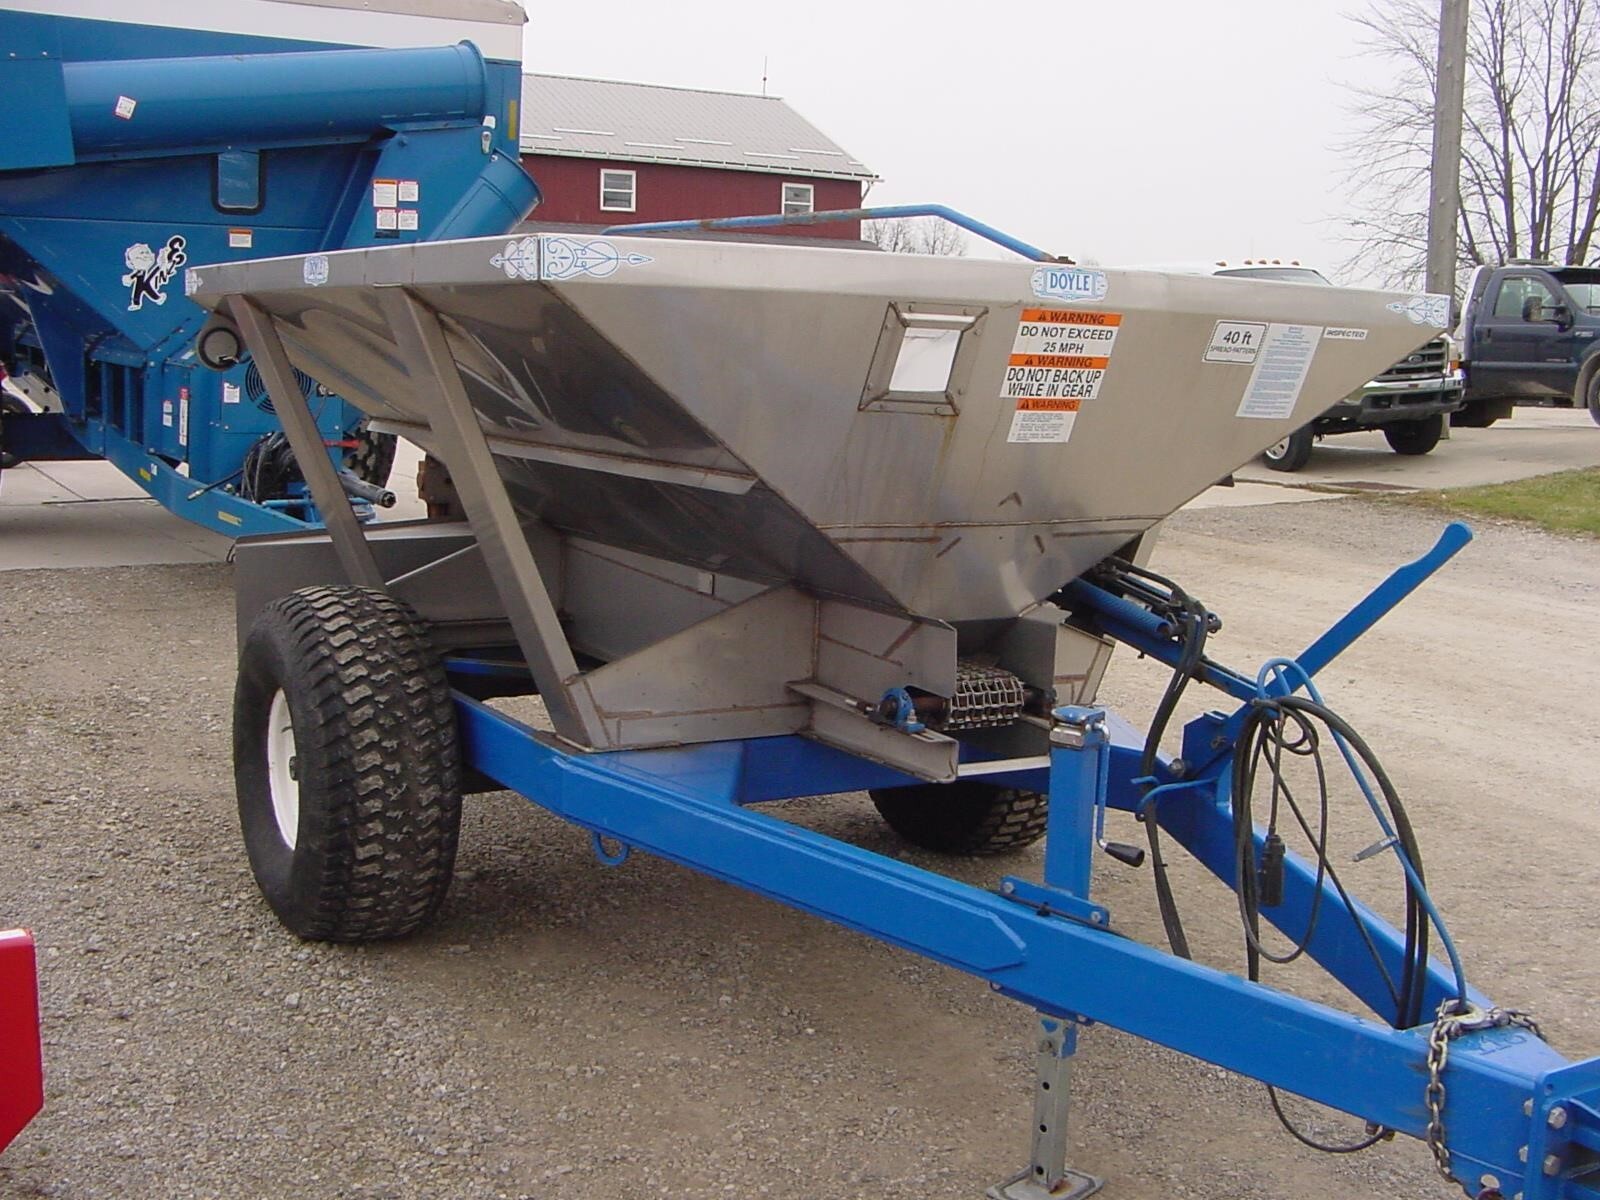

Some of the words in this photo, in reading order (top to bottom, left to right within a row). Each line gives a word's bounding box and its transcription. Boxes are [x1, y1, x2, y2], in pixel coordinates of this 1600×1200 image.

[1050, 272, 1090, 292] DOYLE
[1050, 311, 1106, 325] WARNING
[1020, 325, 1039, 337] DO
[1041, 326, 1067, 338] NOT
[1068, 328, 1113, 341] EXCEED
[1223, 330, 1240, 344] 40
[1241, 330, 1252, 345] ft
[1326, 328, 1366, 338] INSPECTED
[1043, 341, 1057, 353] 25
[1058, 342, 1085, 354] MPH
[1038, 355, 1094, 368] WARNING
[1007, 368, 1025, 381] DO
[1027, 369, 1051, 382] NOT
[1053, 370, 1085, 383] BACK
[1085, 370, 1101, 383] UP
[1008, 382, 1045, 397] WHILE
[1046, 383, 1057, 397] IN
[1062, 384, 1093, 398] GEAR
[1032, 399, 1076, 410] WARNING
